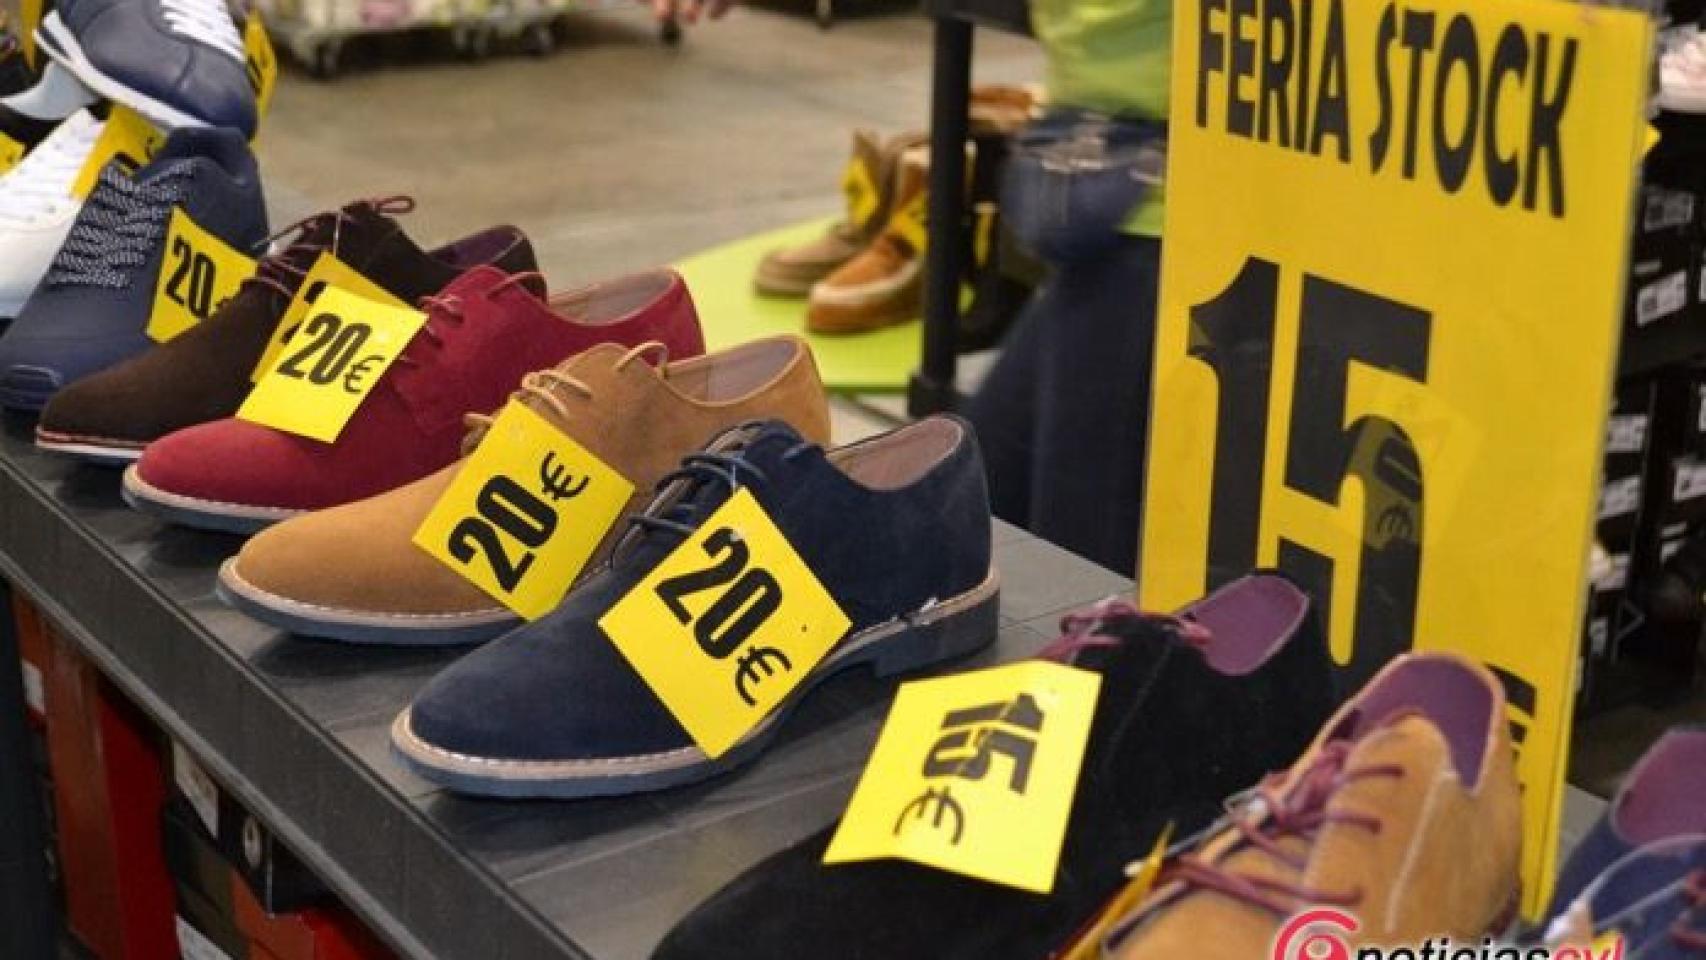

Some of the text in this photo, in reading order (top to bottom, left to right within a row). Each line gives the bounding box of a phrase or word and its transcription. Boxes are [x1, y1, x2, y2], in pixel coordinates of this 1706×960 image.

[1196, 0, 1579, 218] FERIA STOCK
[165, 234, 230, 319] 20
[275, 313, 385, 394] 20€
[447, 450, 591, 594] 20€
[1186, 255, 1433, 690] 15
[654, 526, 792, 706] 20€
[893, 692, 1044, 846] 15€
